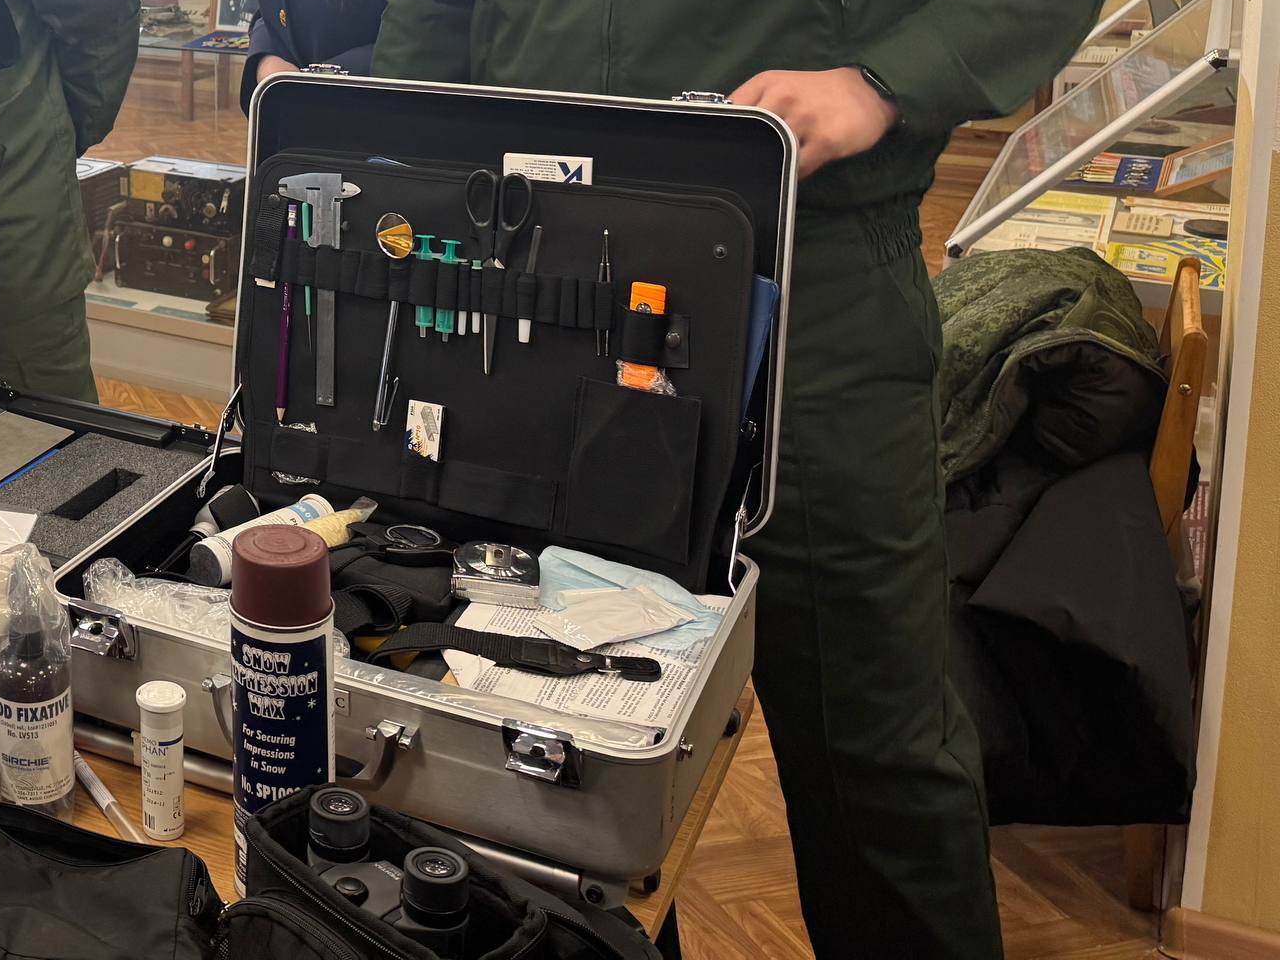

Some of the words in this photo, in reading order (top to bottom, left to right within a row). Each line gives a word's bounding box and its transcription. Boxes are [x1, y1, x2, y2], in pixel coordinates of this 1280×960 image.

[242, 643, 292, 674] SNOW
[231, 658, 319, 697] MPRESSION
[16, 693, 70, 723] FIXATIVE
[247, 692, 286, 720] WAX
[242, 723, 255, 738] For
[255, 729, 297, 747] Securing
[1, 752, 49, 767] SIRCHIE
[243, 739, 296, 760] Impressions
[250, 757, 259, 770] in
[260, 761, 287, 775] Snow
[240, 774, 254, 795] No.
[255, 782, 302, 800] SP100
